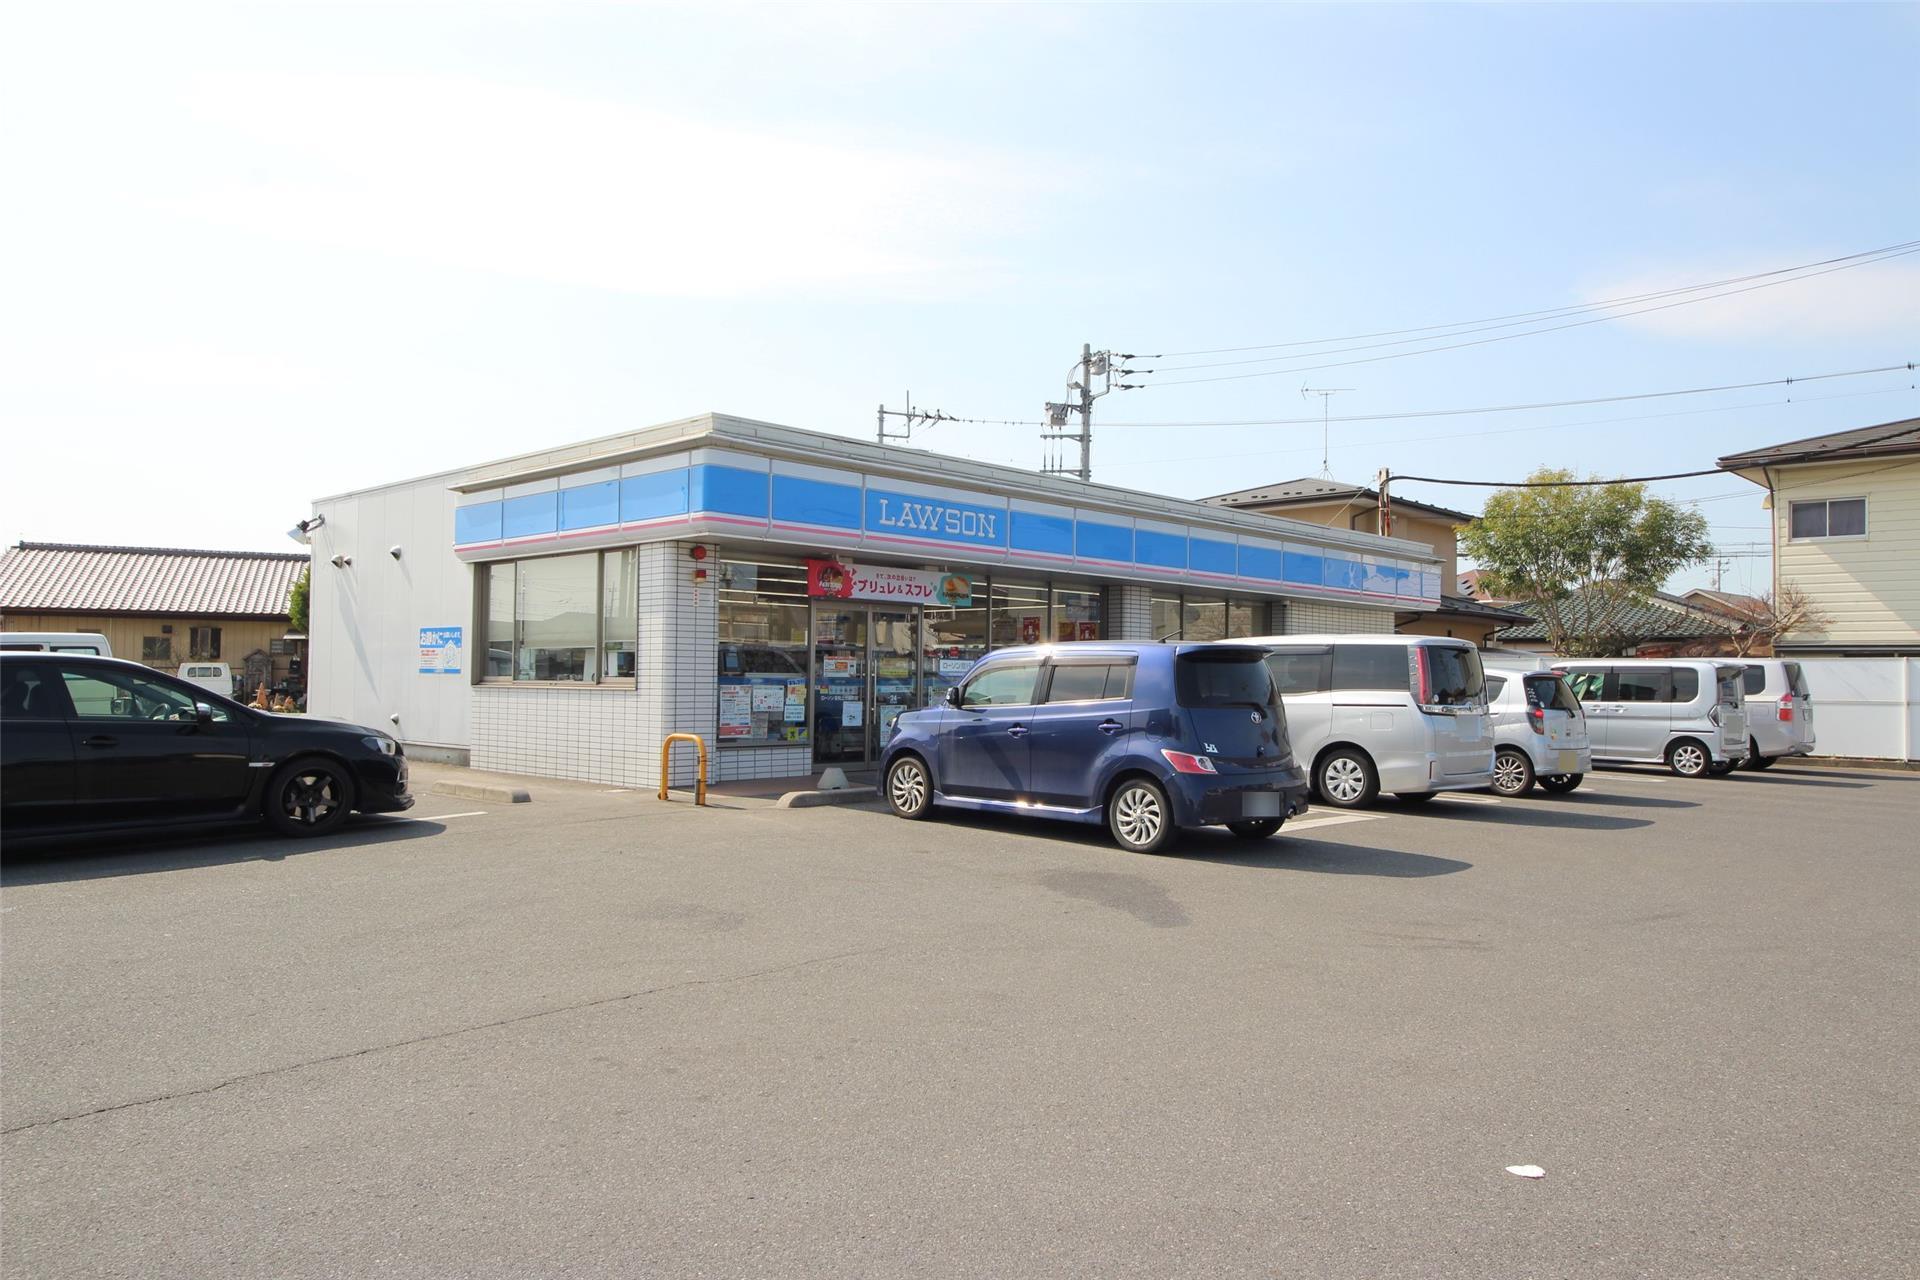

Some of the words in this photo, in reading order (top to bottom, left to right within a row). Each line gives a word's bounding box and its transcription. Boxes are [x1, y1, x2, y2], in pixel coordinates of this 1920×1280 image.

[879, 499, 996, 538] LAWSON
[857, 579, 933, 597] ブリュレ&スフレ
